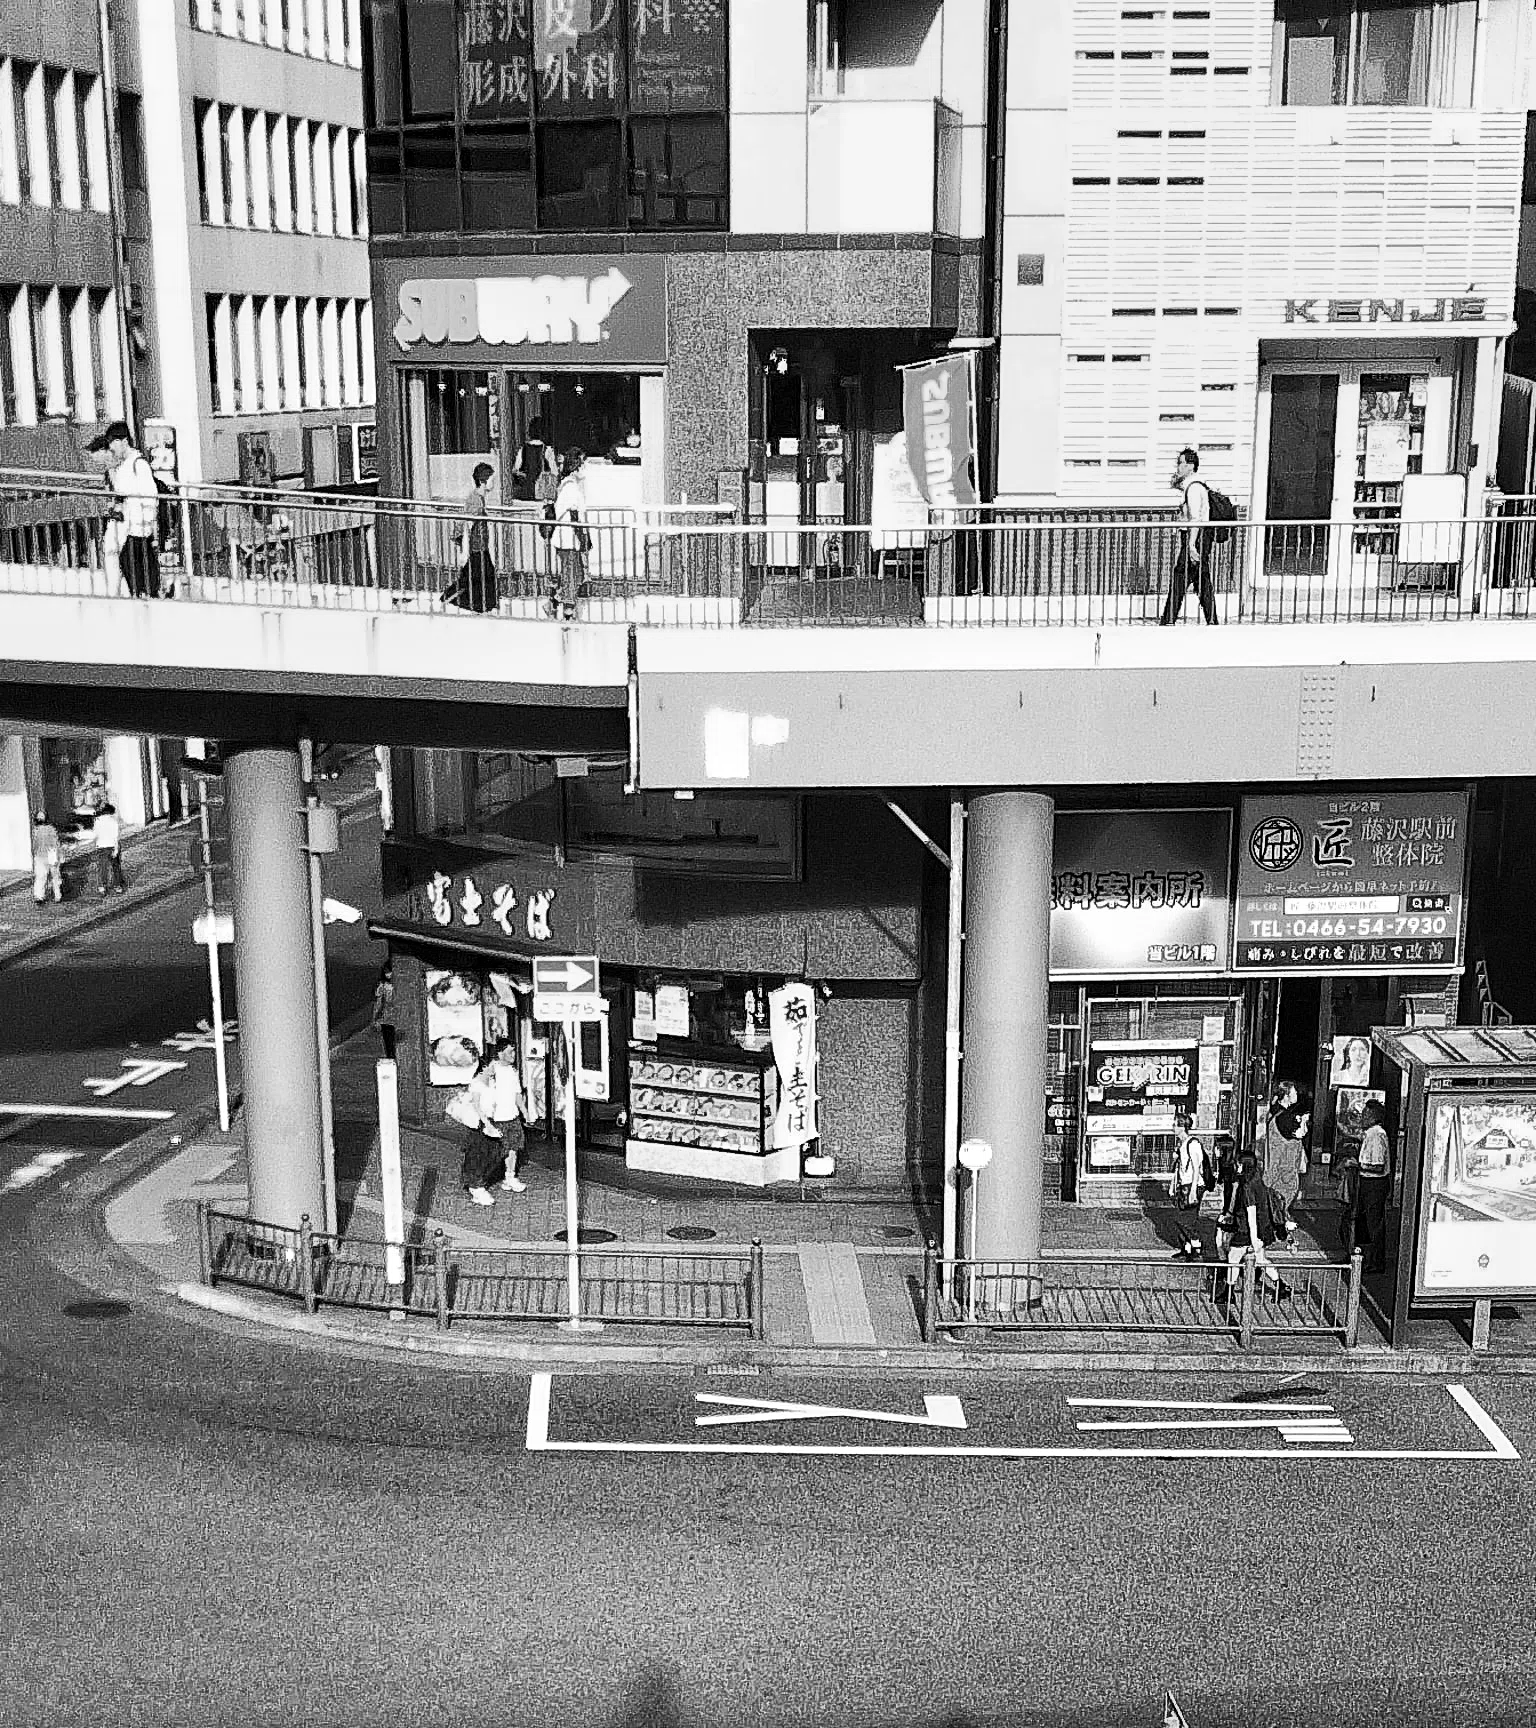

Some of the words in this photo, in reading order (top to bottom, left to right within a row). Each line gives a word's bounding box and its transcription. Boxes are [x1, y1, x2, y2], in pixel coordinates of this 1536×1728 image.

[464, 53, 617, 106] 形成外科
[393, 266, 633, 352] SUBWAY
[1285, 298, 1487, 324] KENJE
[1312, 817, 1356, 868] 匠
[1360, 816, 1457, 842] 藤沢駅前
[1371, 842, 1445, 868] 整体院
[1050, 870, 1204, 910] 料案内所
[539, 1002, 596, 1015] ここから
